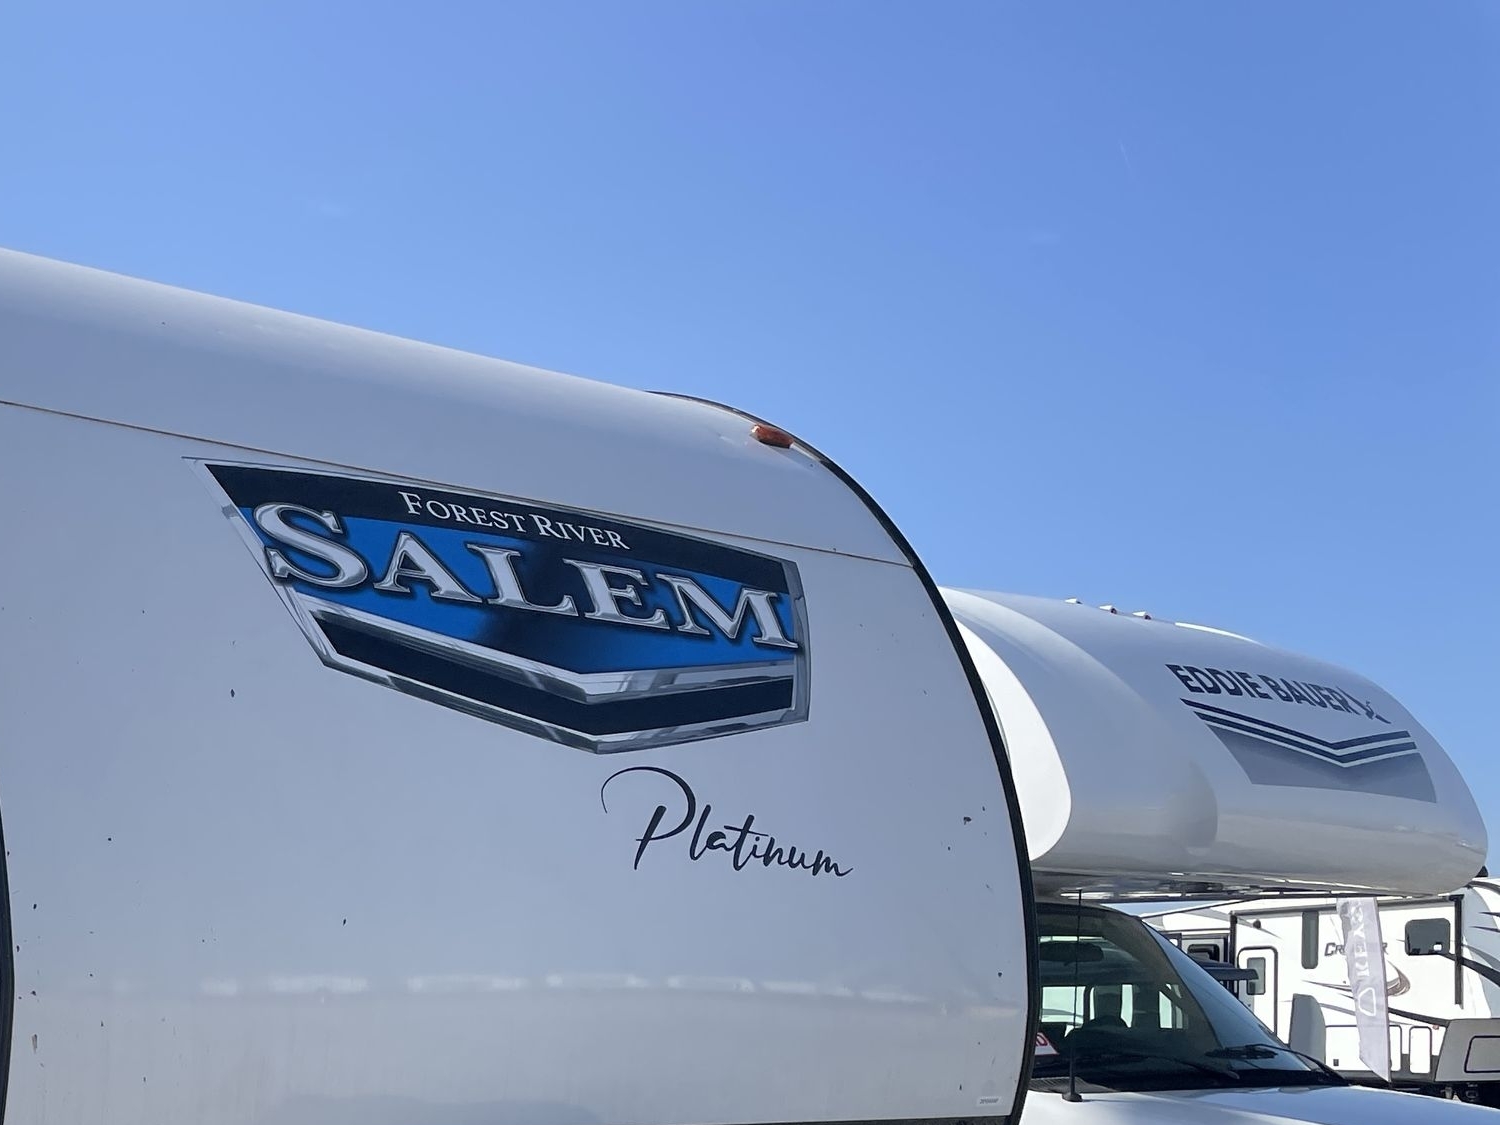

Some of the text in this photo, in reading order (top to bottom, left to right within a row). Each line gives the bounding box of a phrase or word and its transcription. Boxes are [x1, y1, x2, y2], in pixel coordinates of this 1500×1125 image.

[398, 490, 631, 550] FOREST RIVER
[252, 501, 800, 650] SALEM
[1165, 663, 1361, 716] EDDIE BAUER
[601, 766, 853, 877] Platinum
